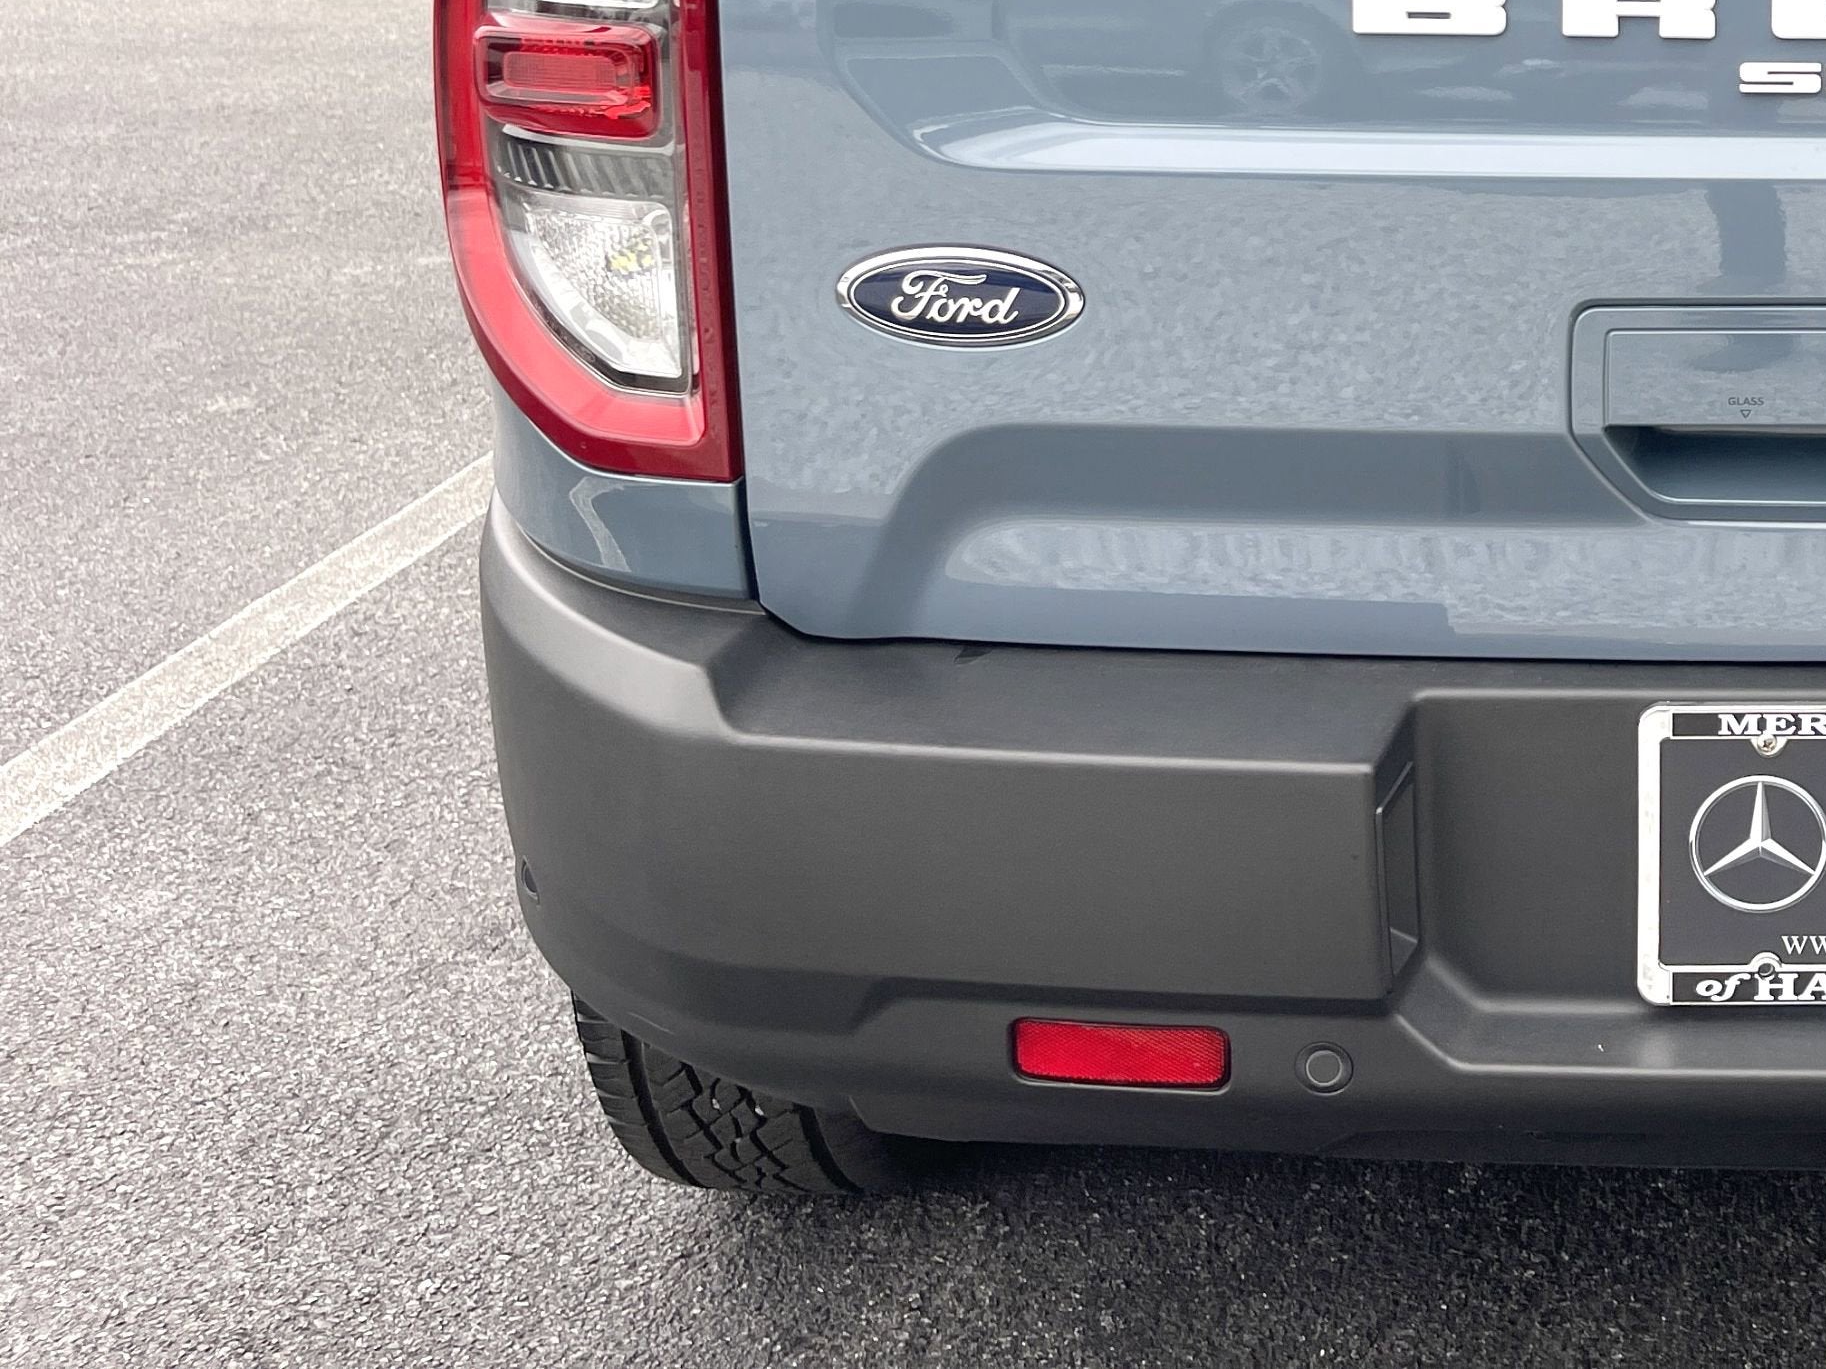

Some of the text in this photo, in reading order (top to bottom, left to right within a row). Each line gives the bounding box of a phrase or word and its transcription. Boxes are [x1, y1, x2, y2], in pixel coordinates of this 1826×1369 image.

[890, 269, 1021, 324] Ford
[1727, 396, 1765, 406] GLASS
[1695, 973, 1744, 1001] of
